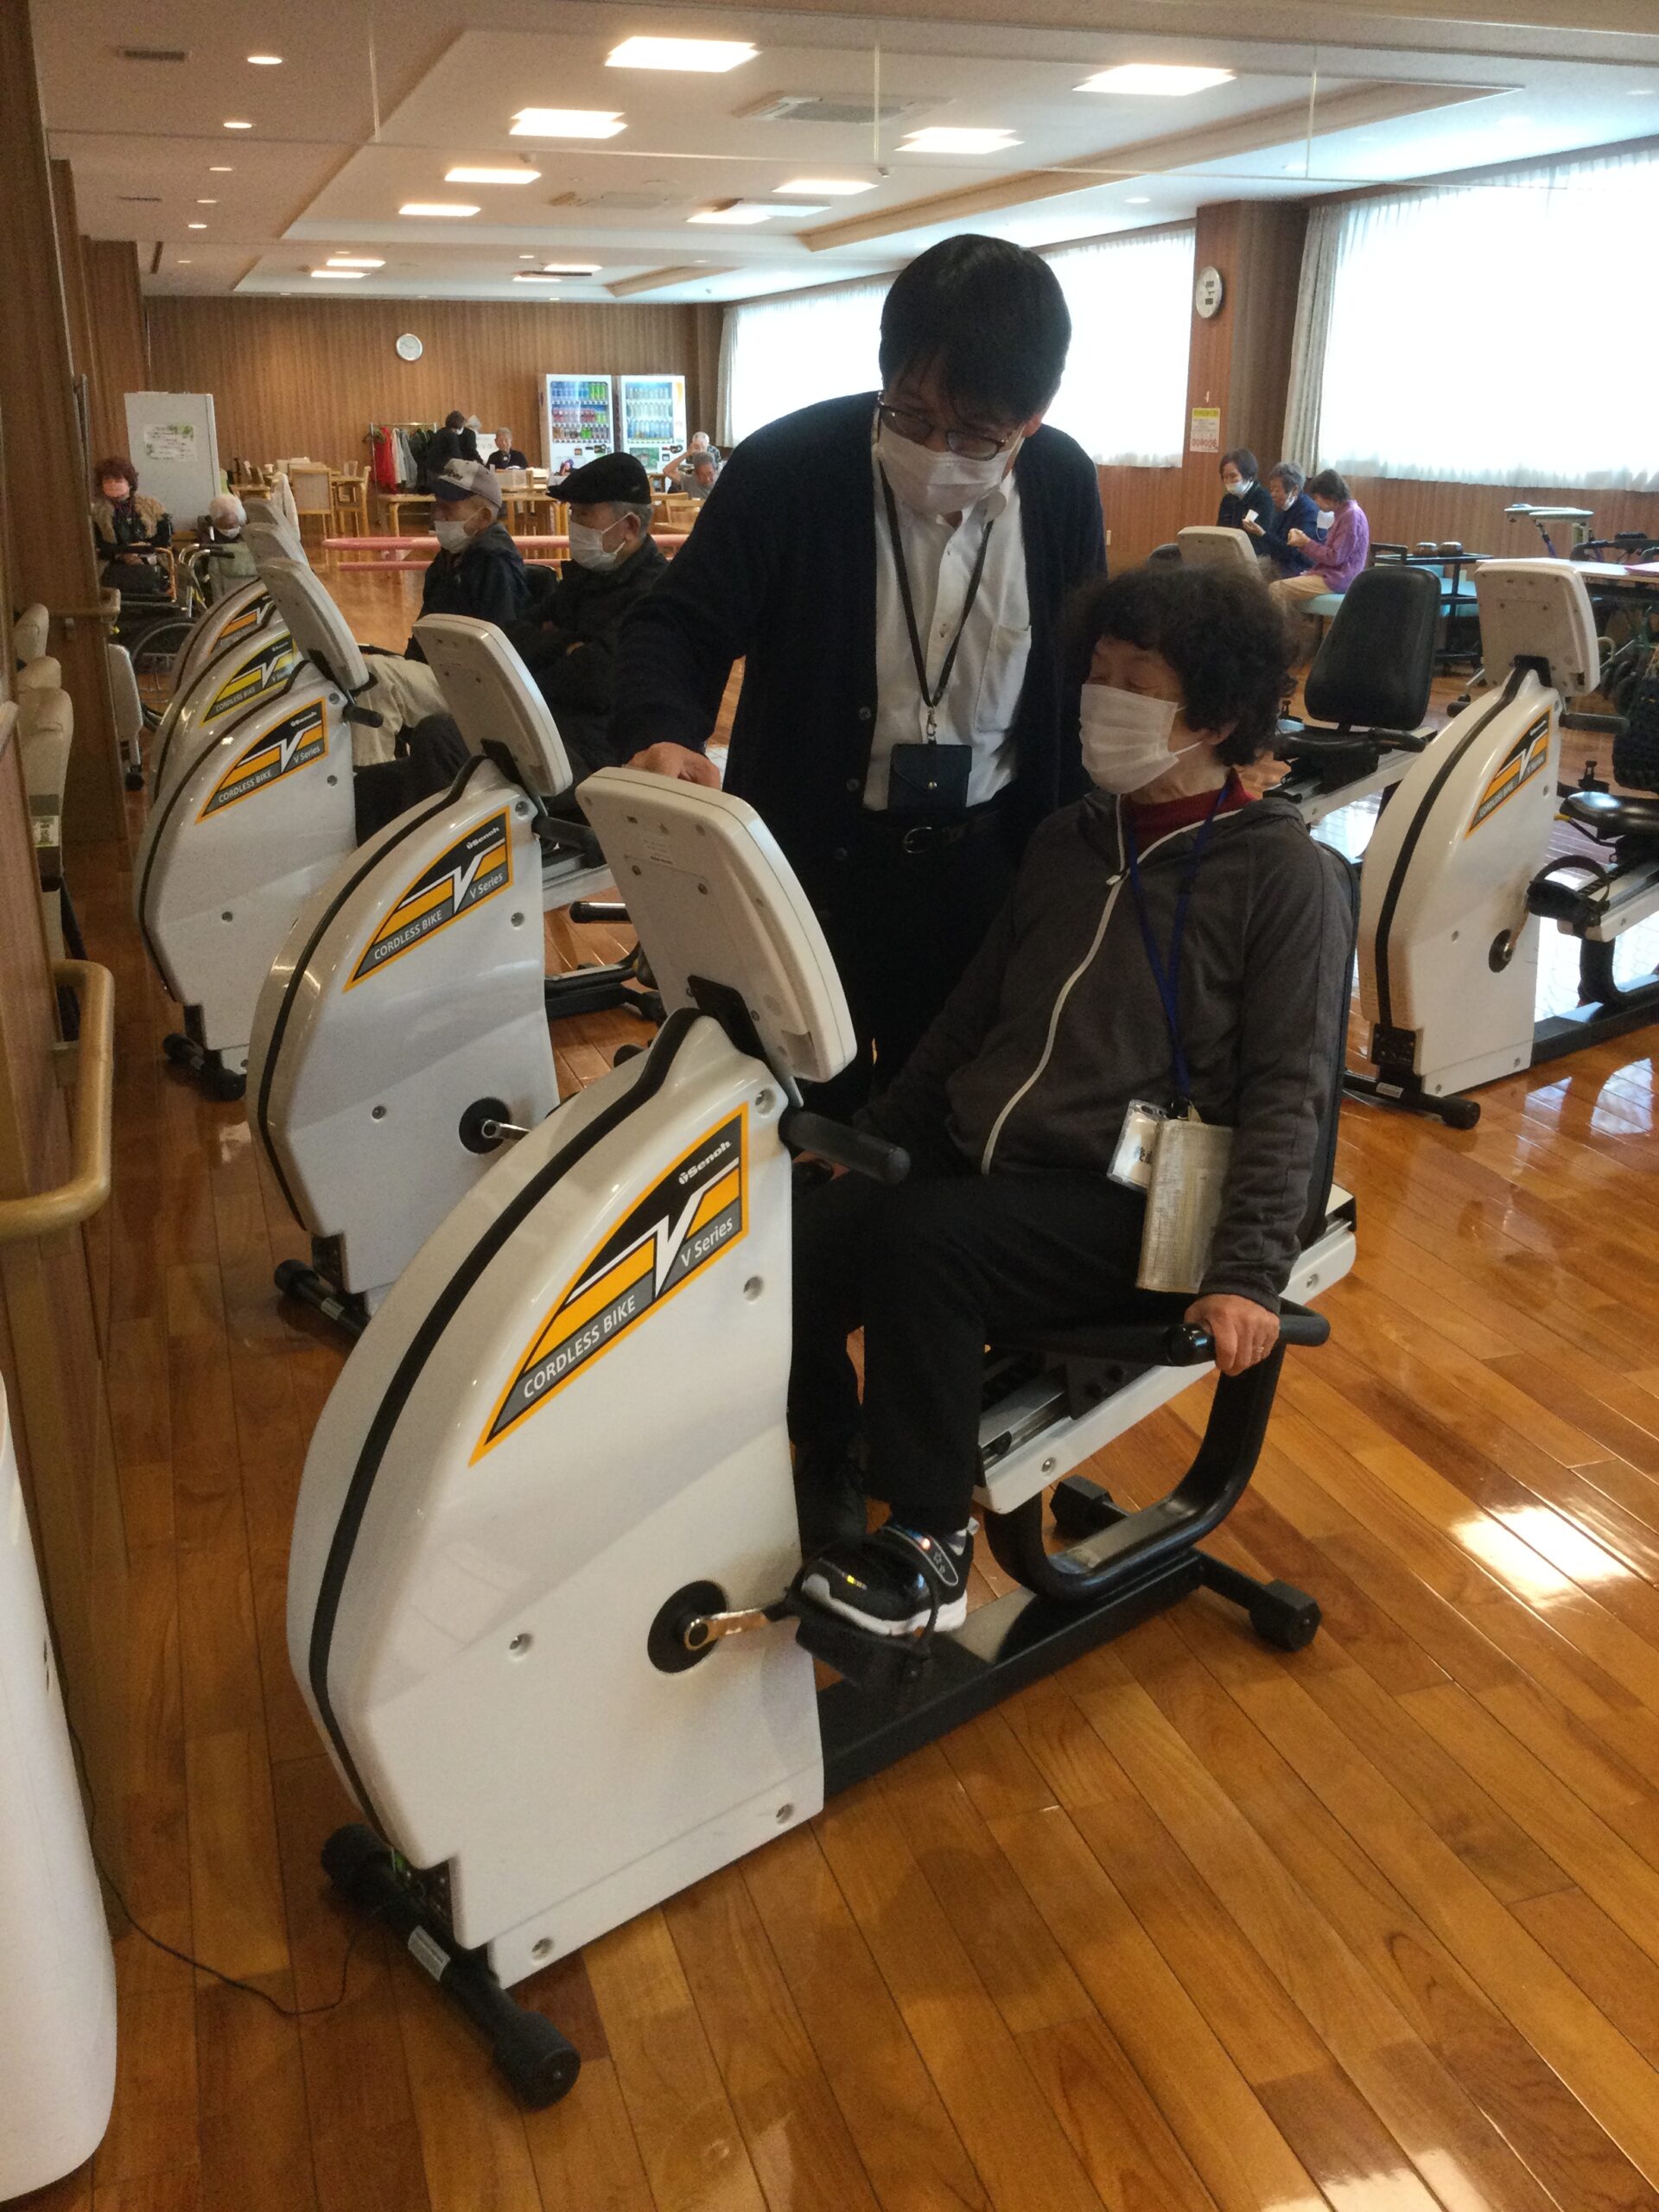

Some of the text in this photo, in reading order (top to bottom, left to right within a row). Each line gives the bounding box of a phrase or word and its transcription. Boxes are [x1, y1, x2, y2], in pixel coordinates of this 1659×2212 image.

[218, 746, 321, 803] CORDLESS BIKE V Series
[374, 873, 504, 960] CORDLESS BIKE V Series
[688, 1141, 732, 1179] Senoh
[524, 1217, 733, 1398] CORDLESS BIKE V Series
